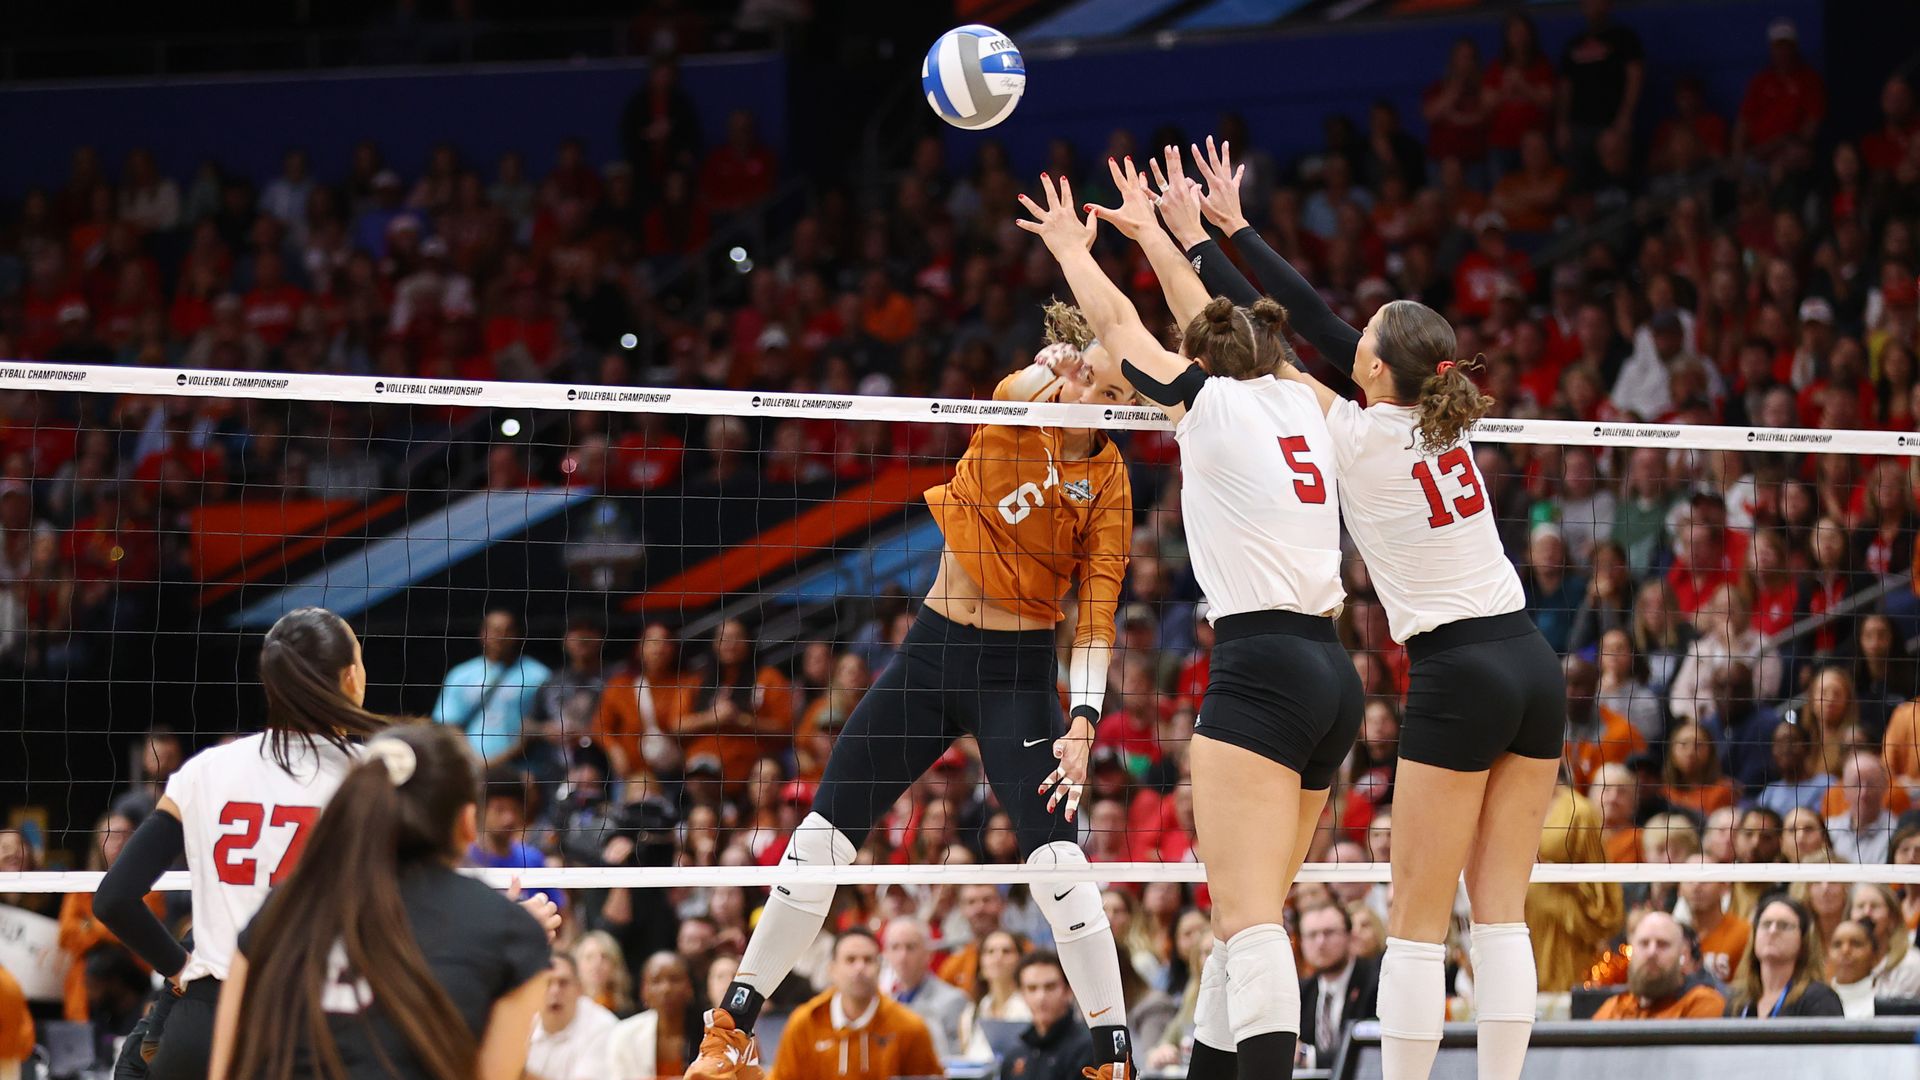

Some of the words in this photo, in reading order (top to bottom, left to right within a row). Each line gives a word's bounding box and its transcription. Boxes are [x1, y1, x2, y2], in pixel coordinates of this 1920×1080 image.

[28, 369, 87, 382] CHAMPIONSHIP
[188, 375, 231, 387] VOLLEYBALL
[232, 377, 289, 389] CHAMPIONSHIP
[385, 383, 427, 395] VOLLEYBALL
[428, 385, 484, 396] CHAMPIONSHIP
[577, 390, 618, 401] VOLLEYBALL
[618, 392, 672, 403] CHAMPIONSHIP
[761, 397, 801, 408] VOLLEYBALL
[801, 399, 853, 410] CHAMPIONSHIP
[940, 404, 978, 415] VOLLEYBALL
[978, 405, 1029, 416] CHAMPIONSHIP
[1113, 410, 1150, 421] VOLLEYBALL
[1150, 412, 1171, 422] CHAM
[1478, 423, 1525, 433] CHAMPIONSHIP
[1601, 428, 1635, 438] VOLLEYBALL
[1635, 430, 1681, 439] CHAMPIONSHIP
[1756, 433, 1788, 443] VOLLEYBALL
[1788, 434, 1833, 444] CHAMPIONSHIP
[1277, 436, 1327, 504] 5
[1411, 447, 1485, 529] 13
[998, 482, 1045, 525] 6
[213, 801, 321, 888] 27
